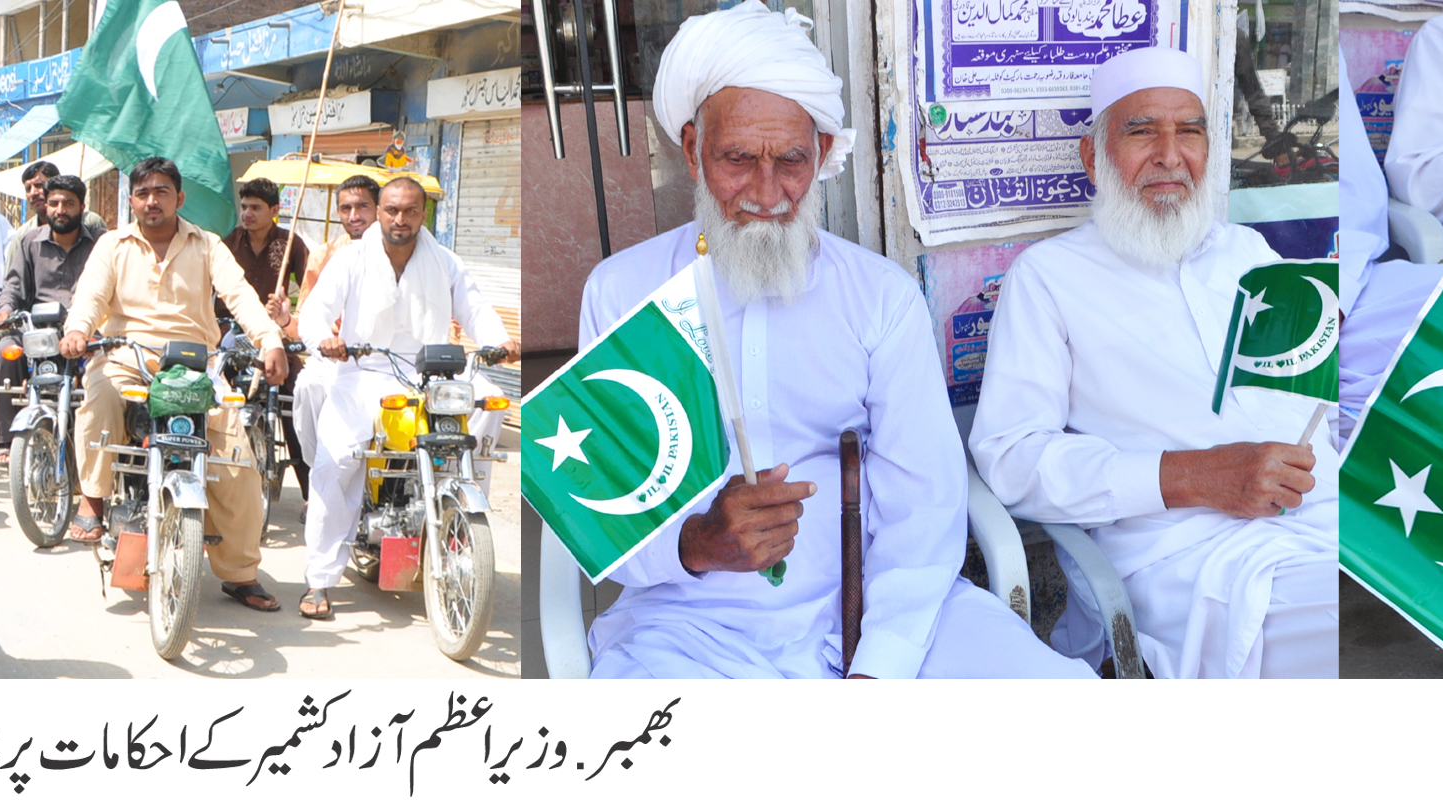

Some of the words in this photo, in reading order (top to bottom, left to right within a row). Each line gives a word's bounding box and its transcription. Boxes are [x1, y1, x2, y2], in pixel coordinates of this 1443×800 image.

[1063, 51, 1095, 60] دوست
[1298, 316, 1336, 361] PAKISTAN
[656, 393, 682, 463] PAKISTAN
